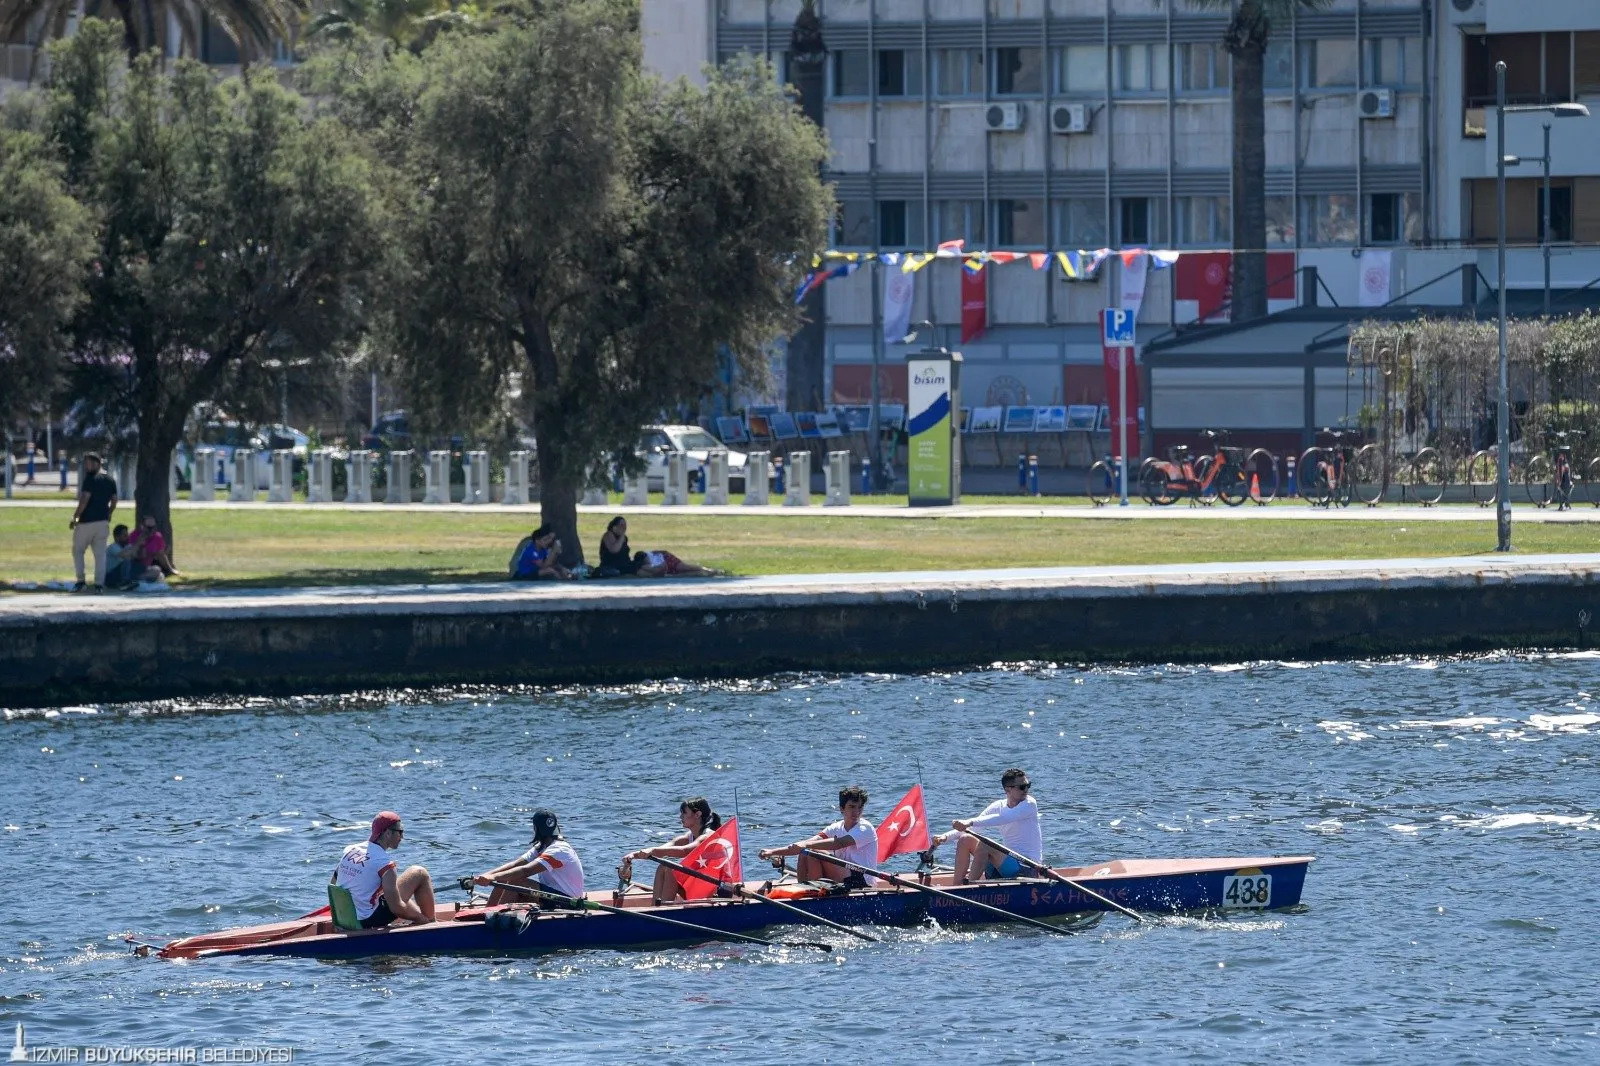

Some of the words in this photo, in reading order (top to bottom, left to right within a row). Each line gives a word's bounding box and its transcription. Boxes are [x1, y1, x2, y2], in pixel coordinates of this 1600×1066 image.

[1113, 310, 1127, 331] P
[914, 374, 945, 384] bisim
[1225, 877, 1269, 905] 438
